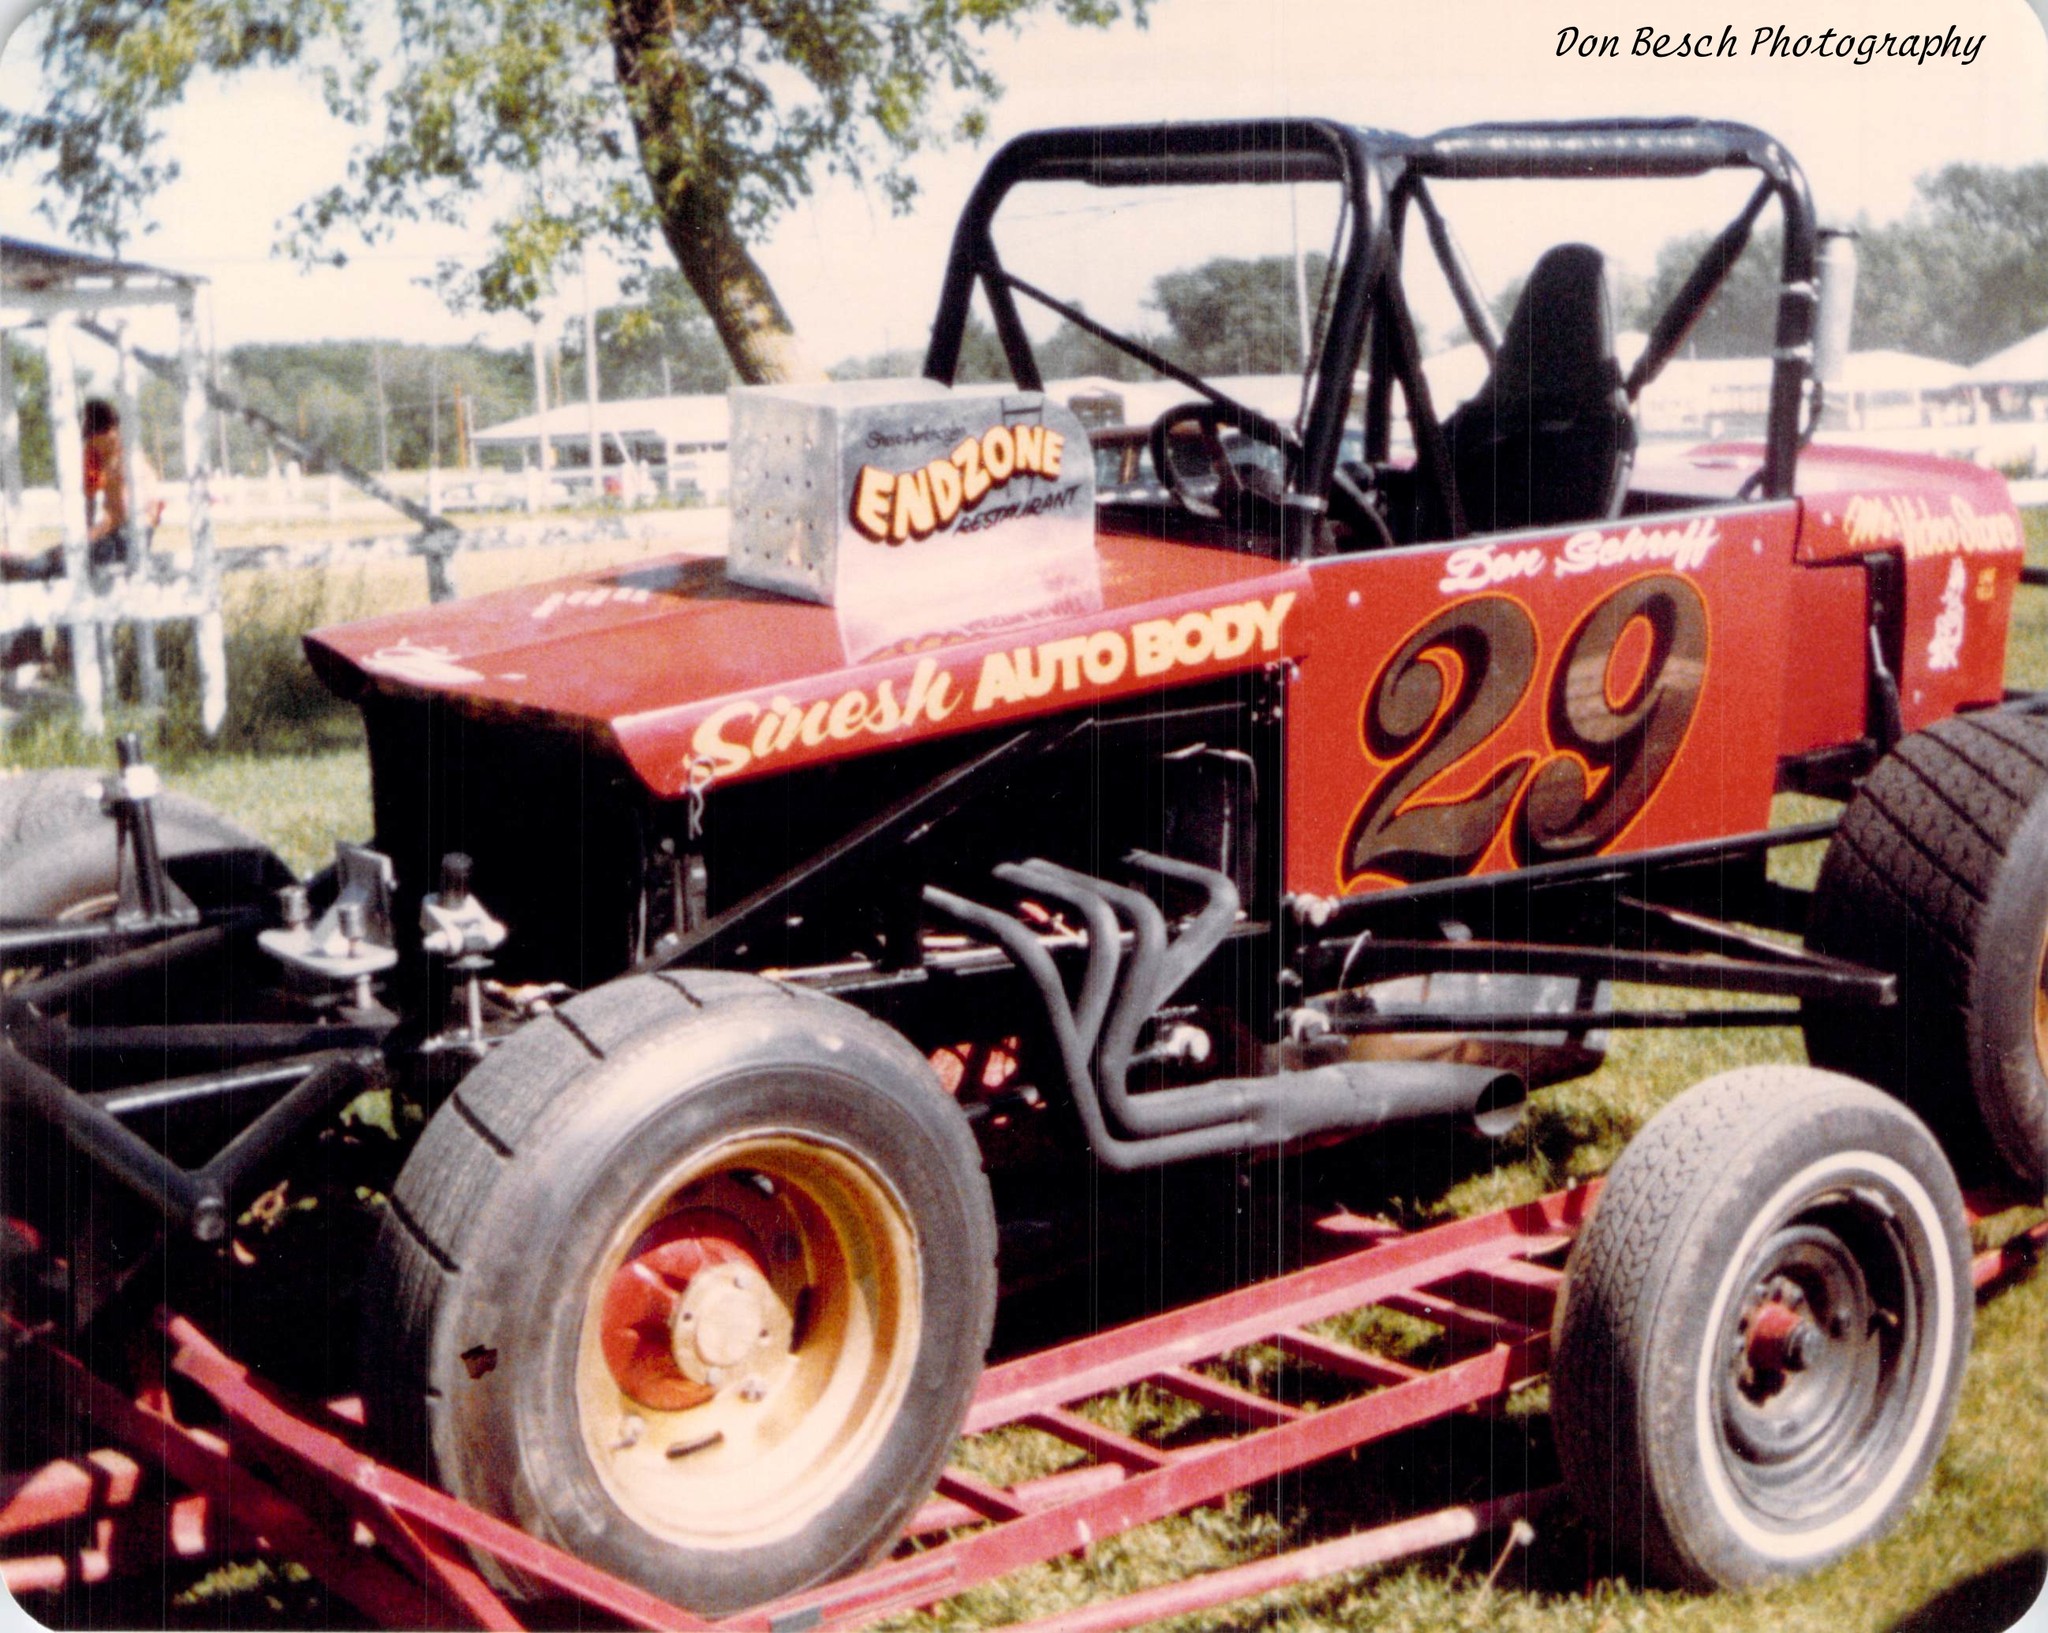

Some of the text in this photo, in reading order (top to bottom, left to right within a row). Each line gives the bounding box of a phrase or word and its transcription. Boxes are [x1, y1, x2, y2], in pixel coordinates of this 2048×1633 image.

[849, 424, 1064, 545] ENDZONE
[1438, 546, 1546, 592] Don
[683, 593, 1295, 779] Sinesh AUTO BODY
[1336, 569, 1711, 895] 29
